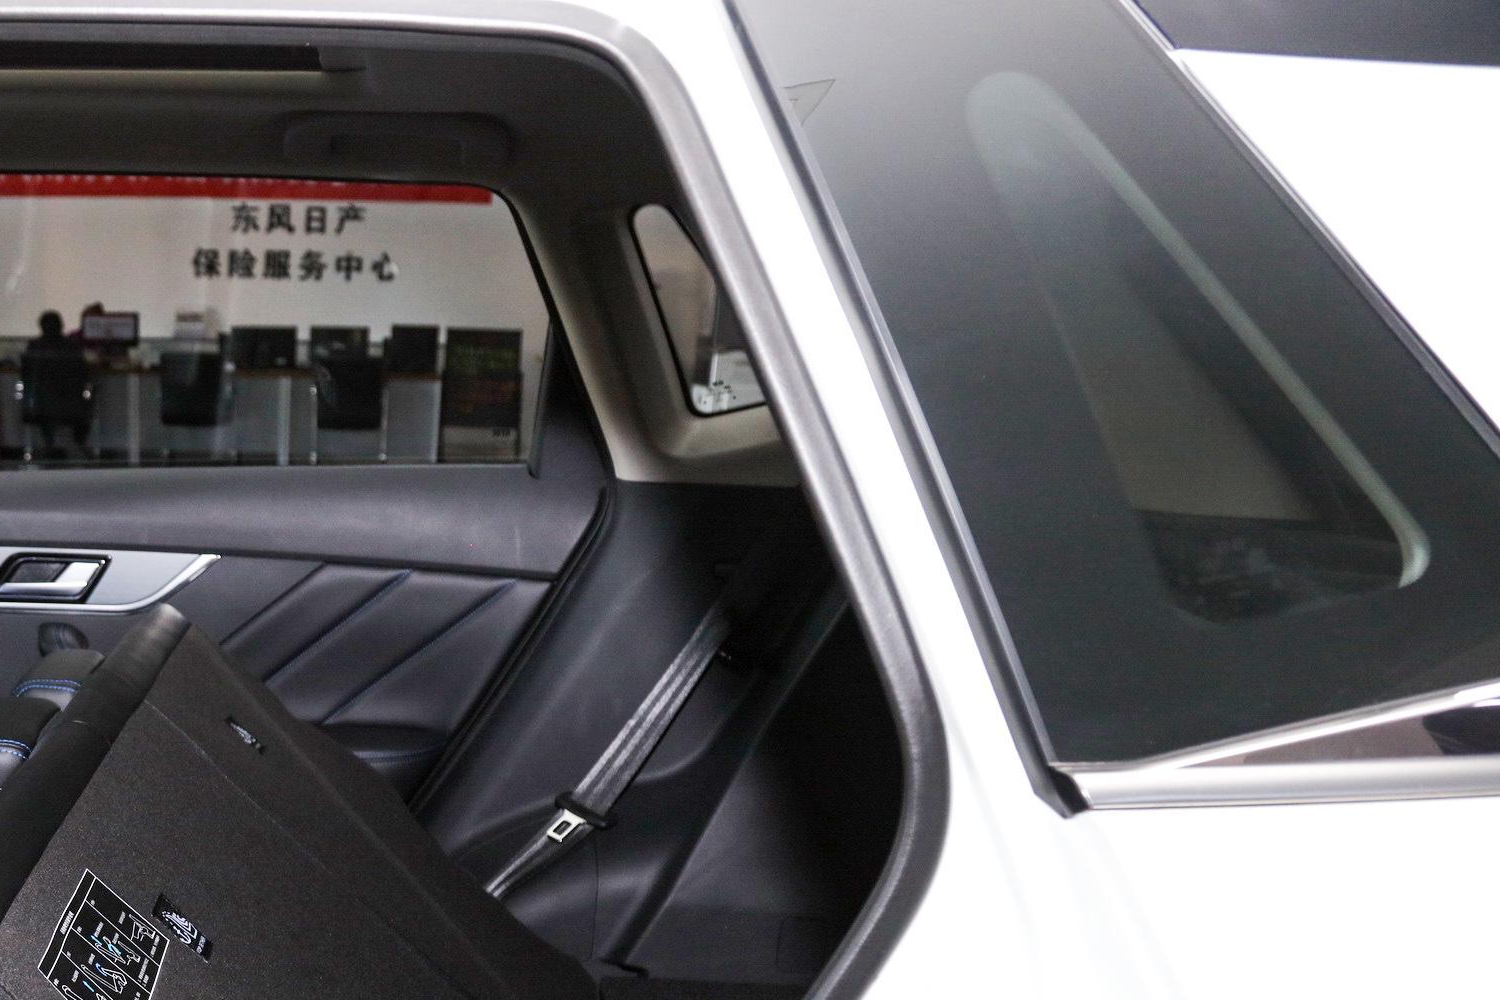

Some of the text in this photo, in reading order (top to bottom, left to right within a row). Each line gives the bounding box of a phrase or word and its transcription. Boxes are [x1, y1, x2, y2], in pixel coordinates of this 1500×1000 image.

[232, 203, 367, 234] 东风日产
[193, 248, 396, 282] 保险服务中心
